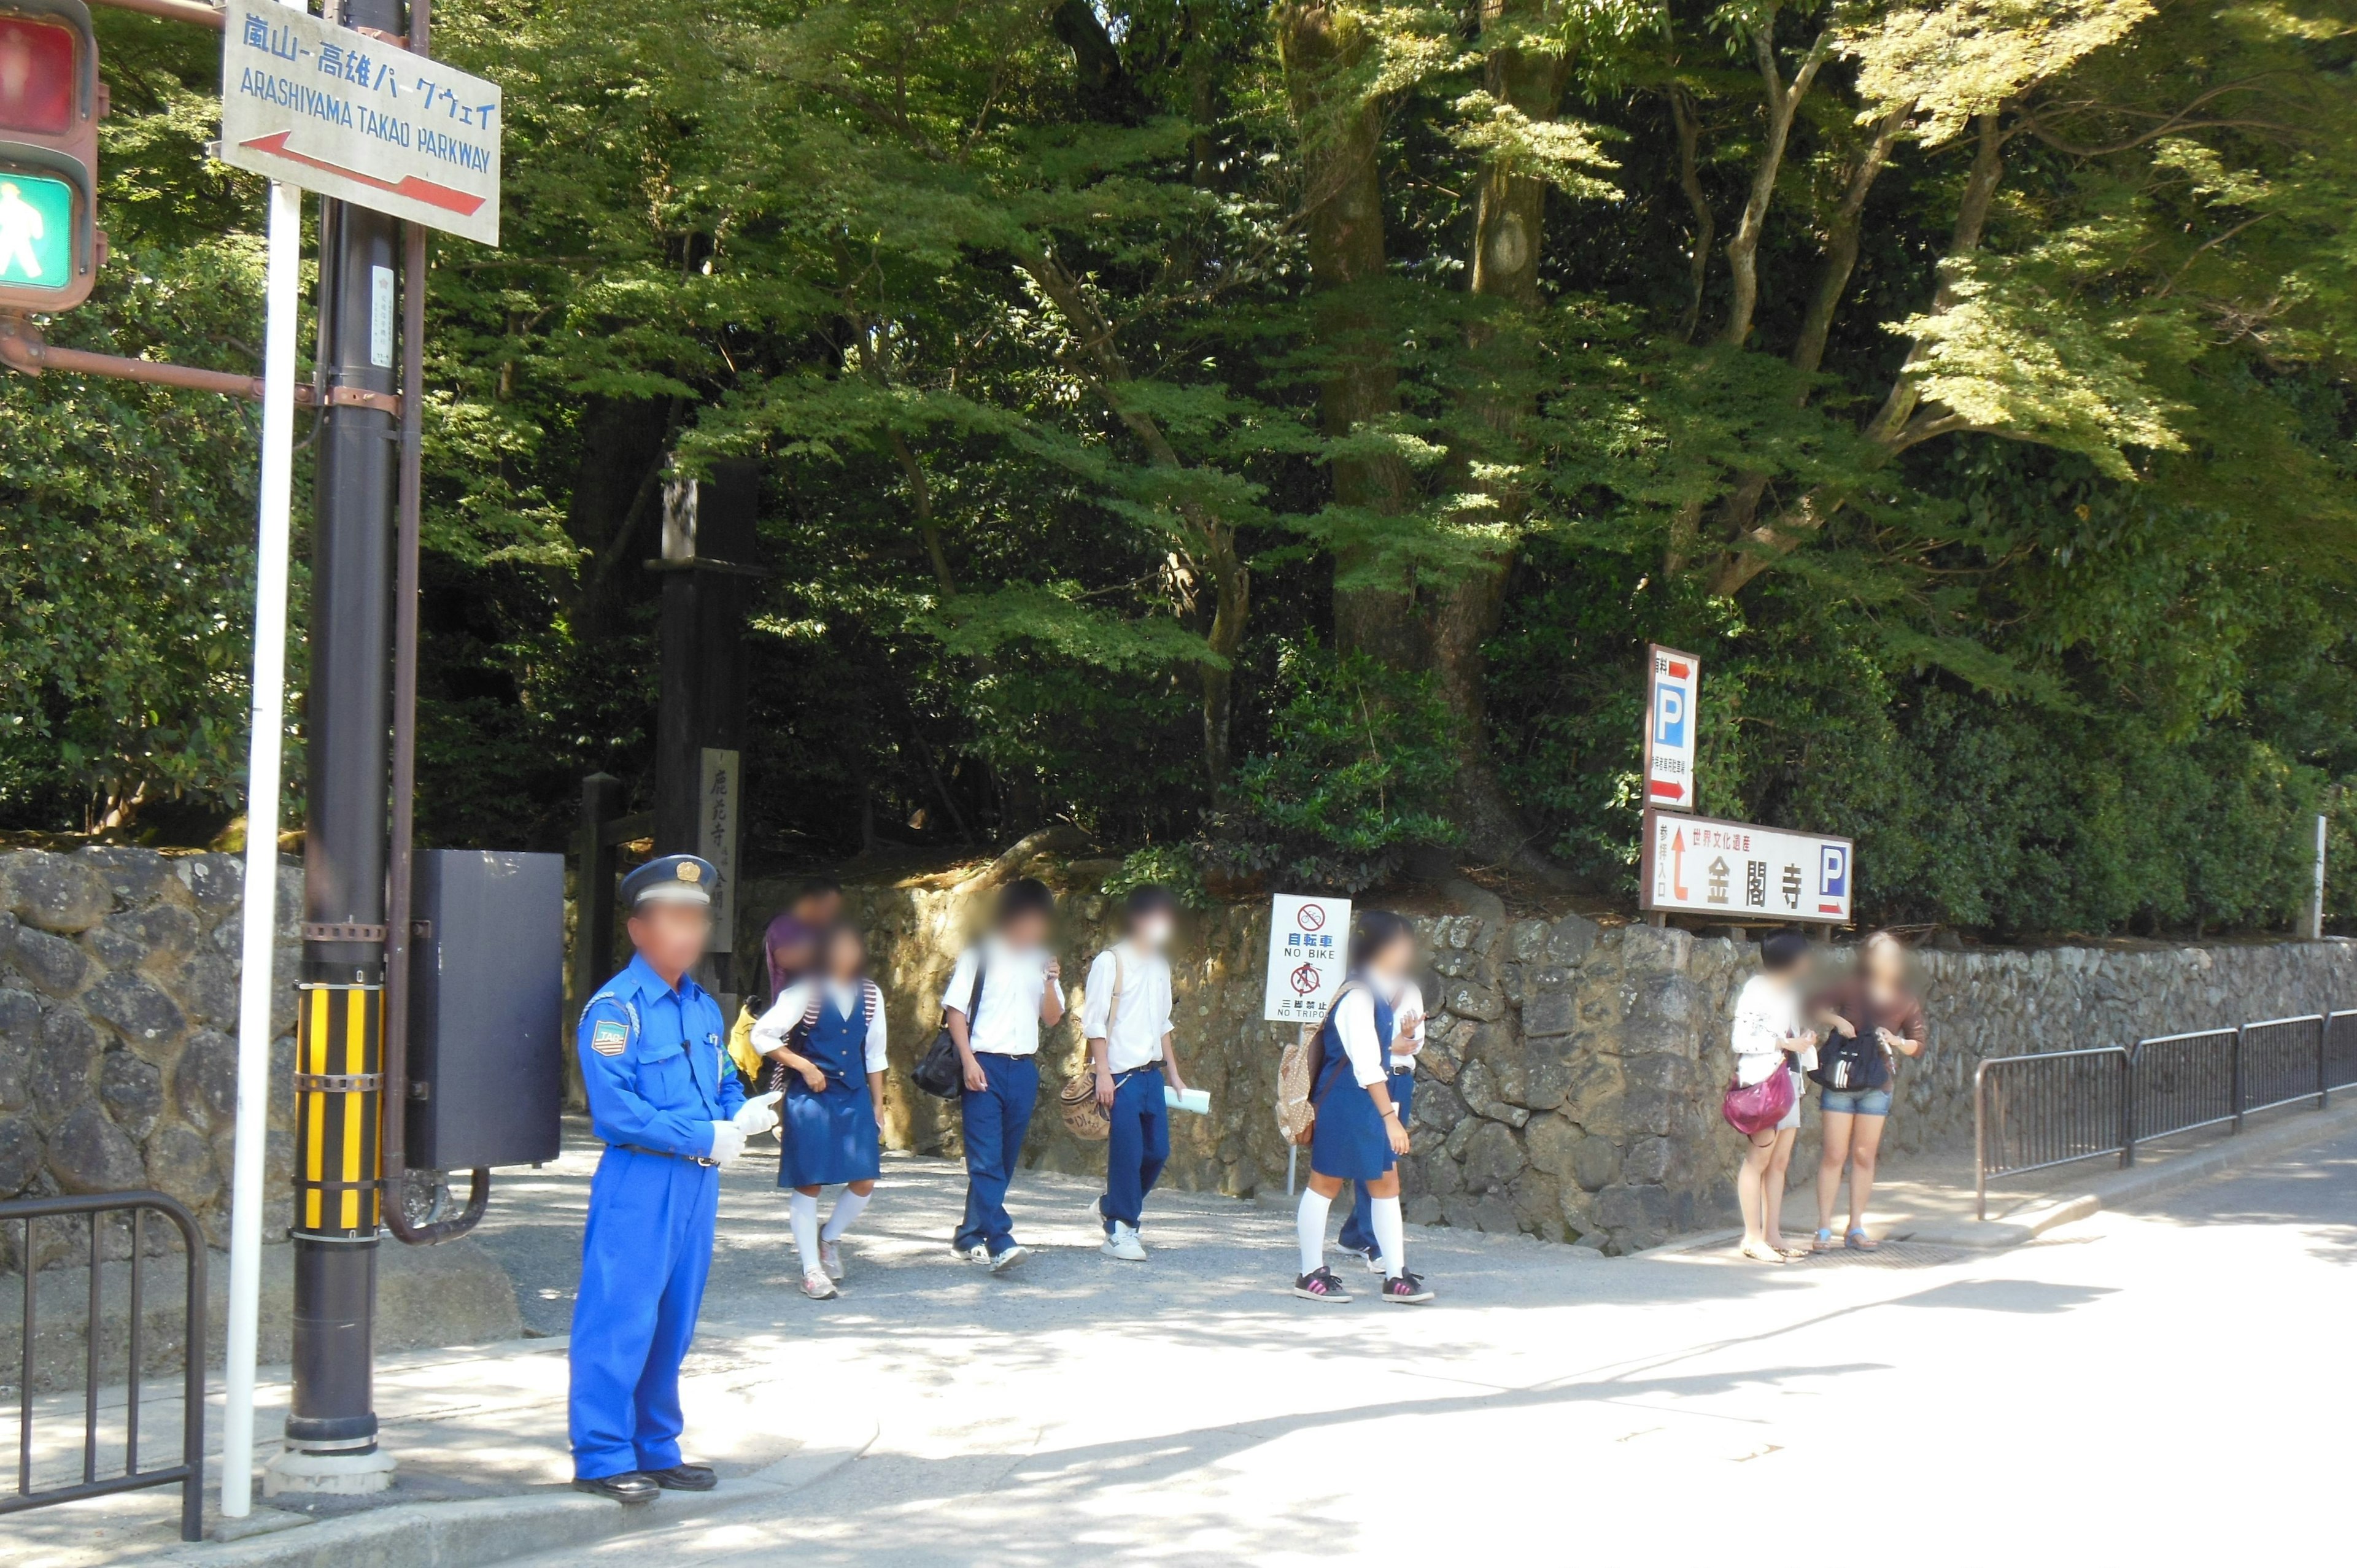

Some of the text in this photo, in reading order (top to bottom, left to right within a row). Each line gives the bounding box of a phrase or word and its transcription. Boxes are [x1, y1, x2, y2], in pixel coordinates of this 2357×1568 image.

[241, 67, 490, 174] ARASHIYAMA TAKAO PARKWAY
[1658, 689, 1682, 740] P
[1693, 828, 1751, 852] 世界文化遺産
[1707, 855, 1802, 910] 金閣寺
[1822, 848, 1843, 893] P
[1288, 933, 1333, 948] 自転車
[1284, 948, 1335, 959] NO BIKE
[1281, 999, 1327, 1010] 三脚禁止
[1296, 1010, 1325, 1018] TRIPO
